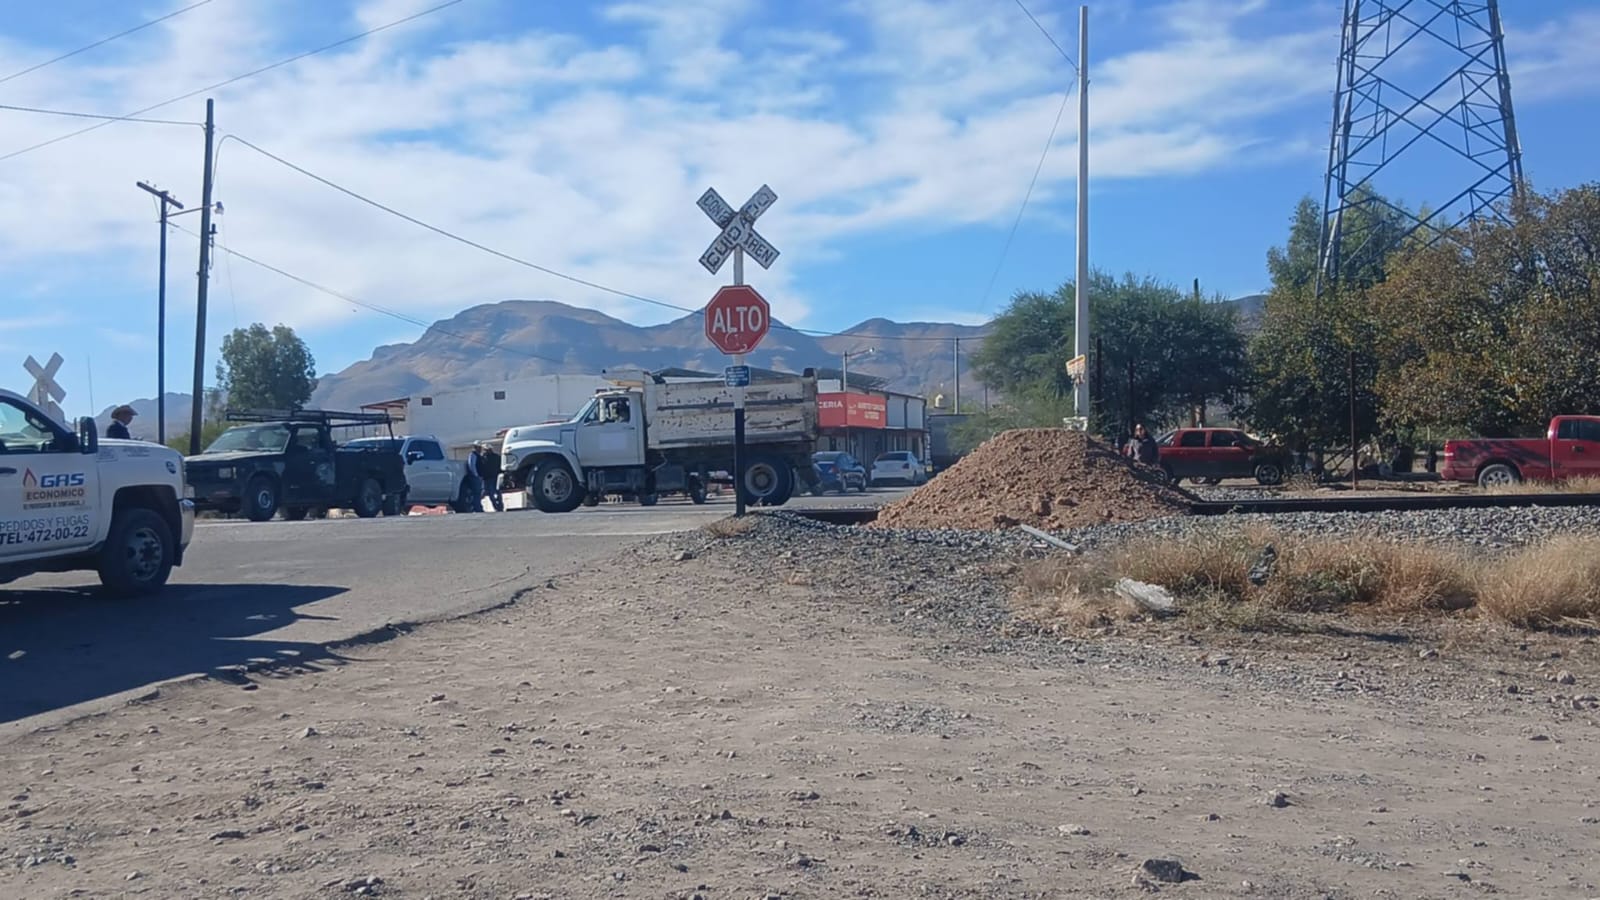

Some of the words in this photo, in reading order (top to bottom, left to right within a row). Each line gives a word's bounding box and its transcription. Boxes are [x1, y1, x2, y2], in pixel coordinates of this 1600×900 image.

[712, 305, 762, 333] ALTO
[41, 473, 85, 488] GAS
[26, 488, 85, 500] ECONOMICO
[0, 518, 46, 532] PEDIDOS
[56, 514, 89, 528] FUGAS
